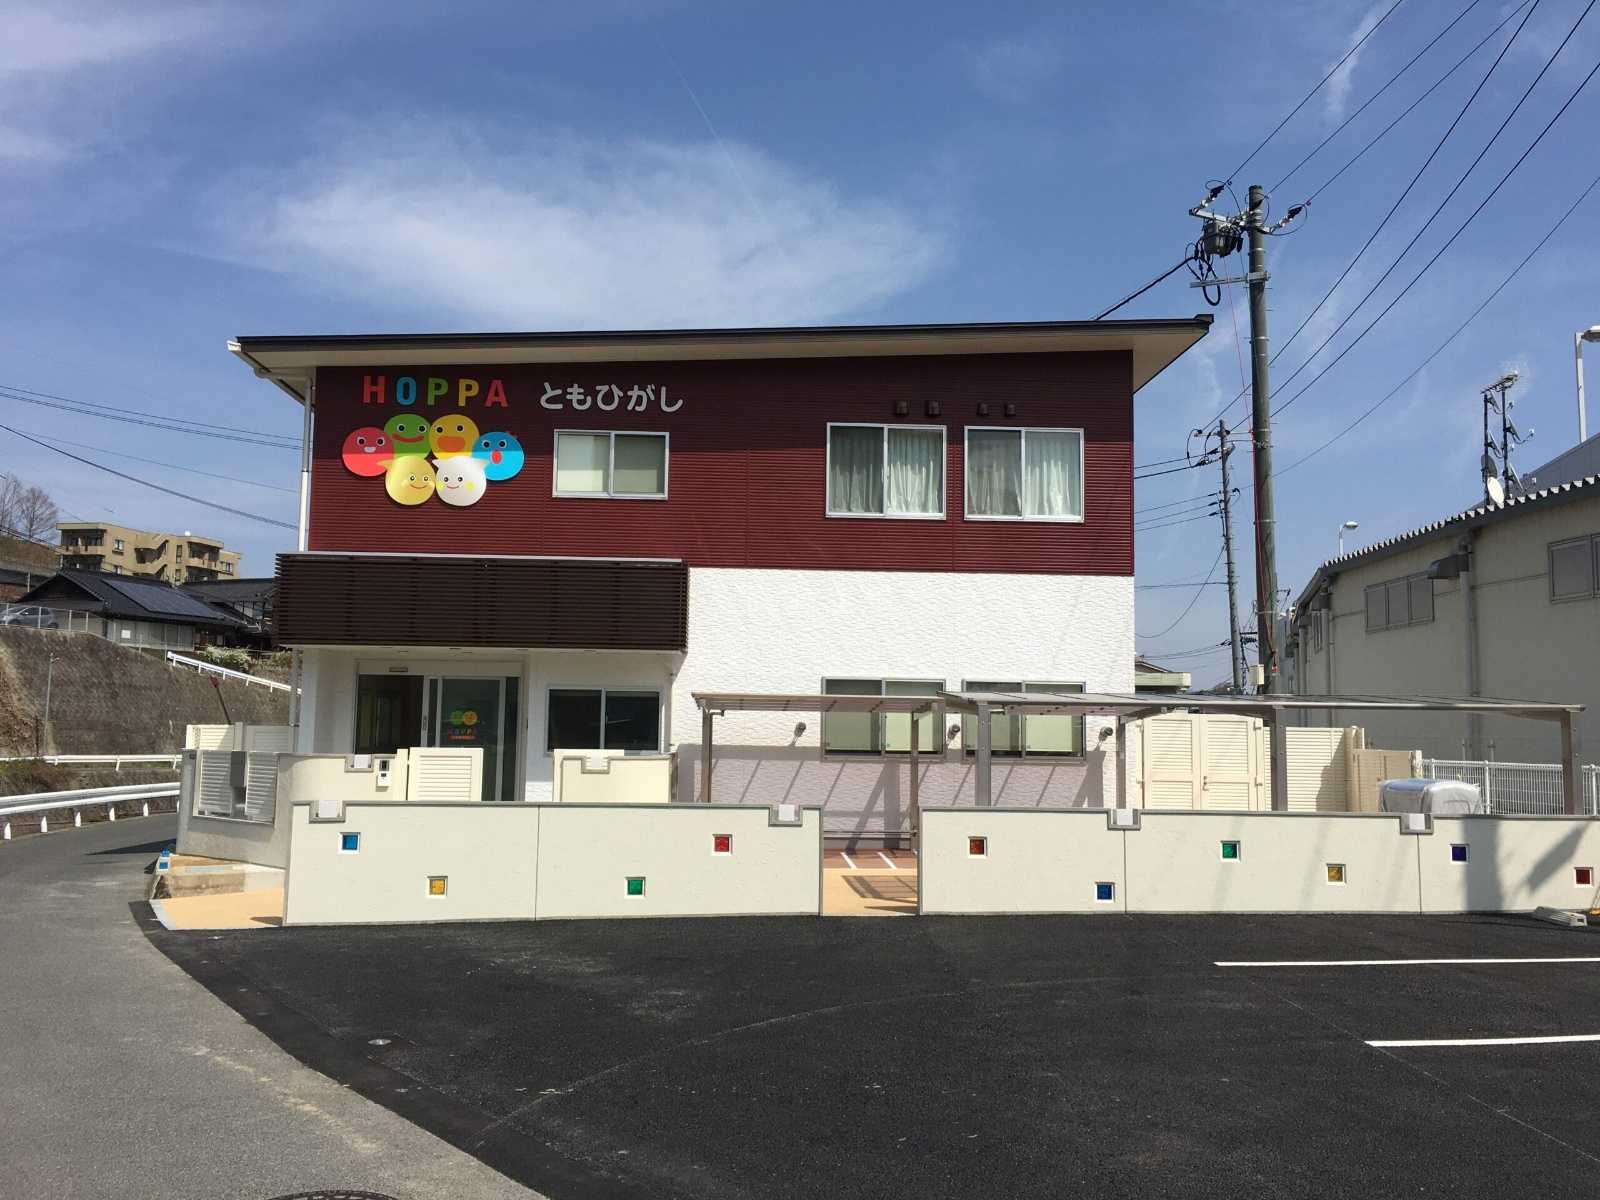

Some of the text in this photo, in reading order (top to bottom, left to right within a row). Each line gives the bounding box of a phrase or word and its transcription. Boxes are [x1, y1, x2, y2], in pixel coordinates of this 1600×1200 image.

[362, 375, 509, 408] HOPPA
[539, 382, 684, 413] ともひがし
